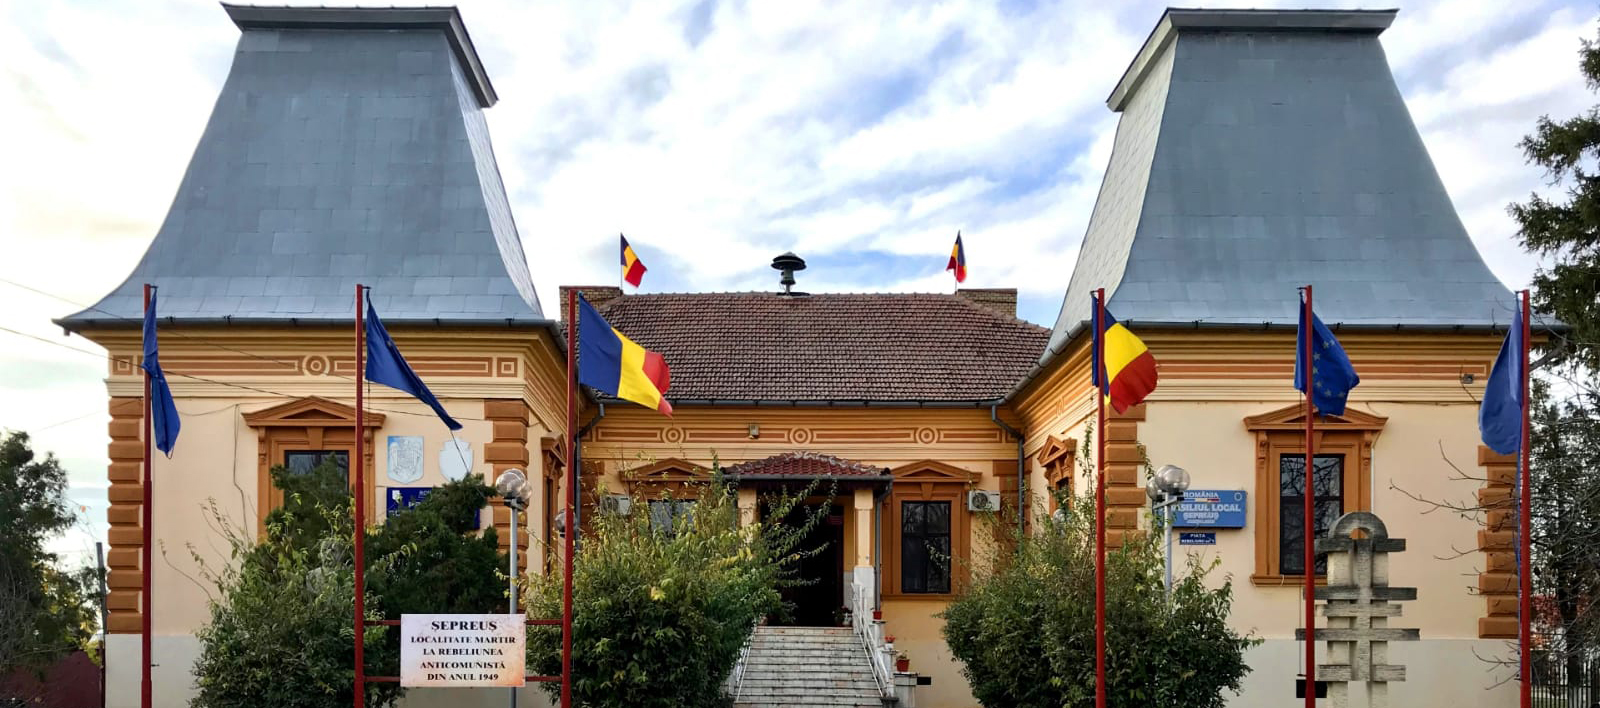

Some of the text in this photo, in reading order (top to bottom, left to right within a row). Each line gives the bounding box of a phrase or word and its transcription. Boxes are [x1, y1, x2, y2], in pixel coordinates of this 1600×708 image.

[1183, 491, 1219, 499] ROMÂNIA
[1212, 503, 1241, 512] LOCAL
[410, 636, 516, 644] LOCALITATE MARTIR
[423, 648, 503, 656] LA REBELIUNEA
[420, 660, 506, 669] ANTICOMUNISTĂ
[427, 673, 499, 681] DIN ANUL 1949
